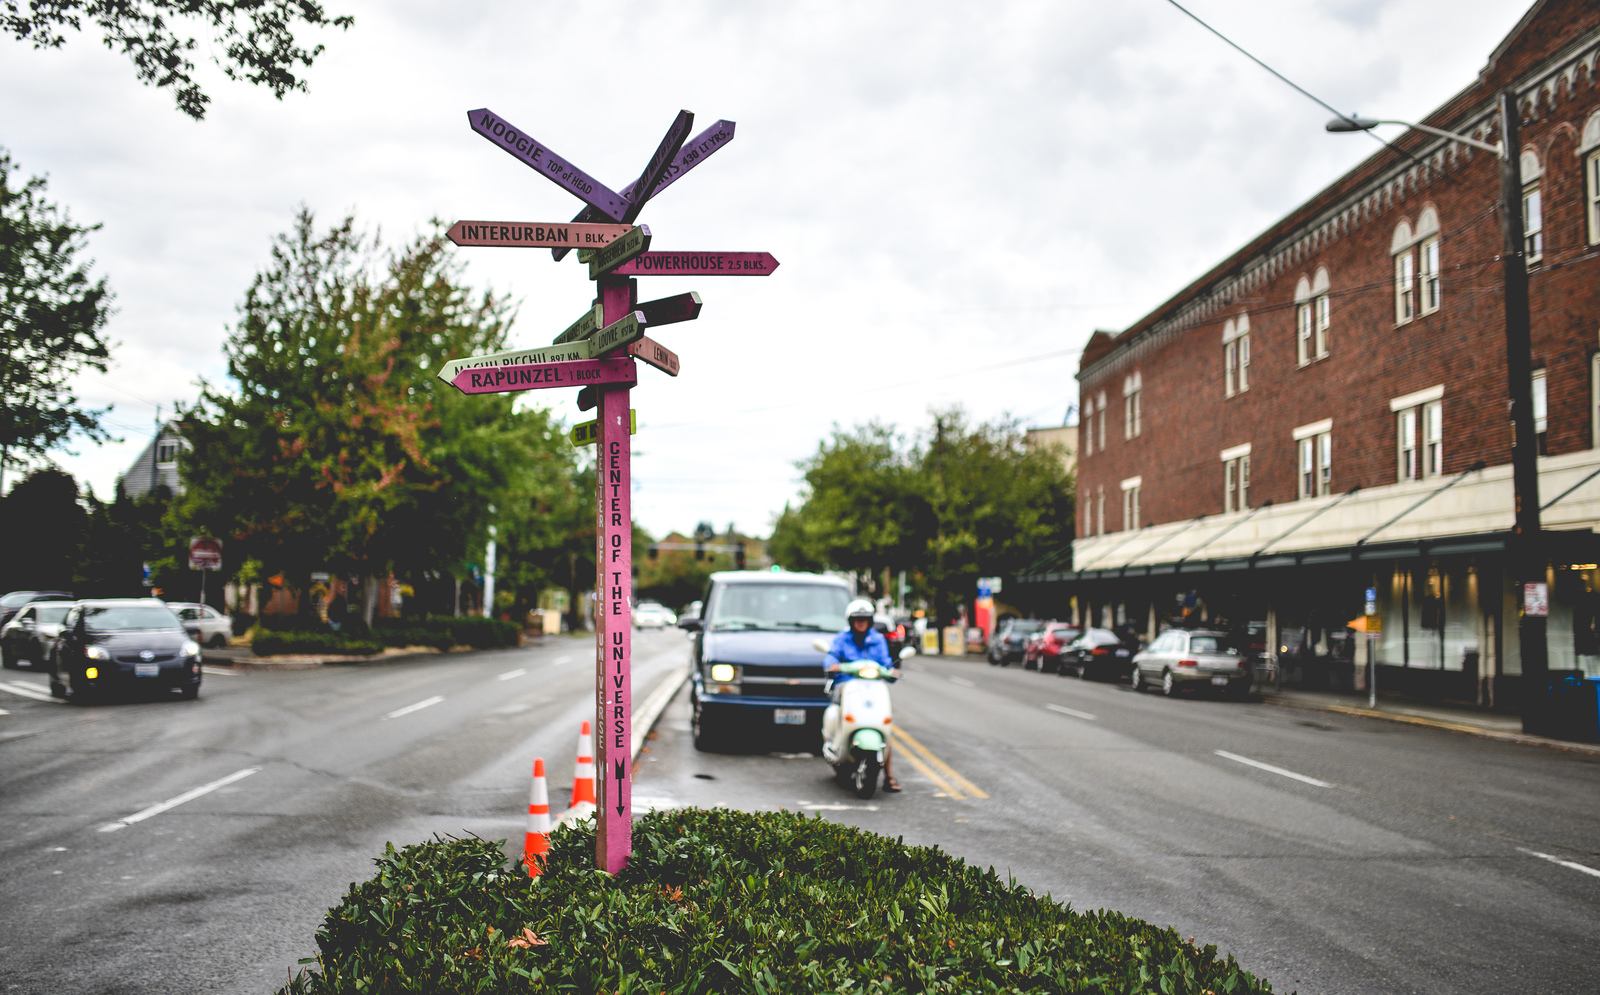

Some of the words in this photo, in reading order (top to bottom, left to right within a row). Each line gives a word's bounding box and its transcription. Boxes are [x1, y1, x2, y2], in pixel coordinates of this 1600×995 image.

[481, 114, 543, 161] NOOGIE
[547, 160, 563, 174] TOP
[562, 172, 573, 181] of
[571, 177, 592, 194] HEAD
[682, 149, 699, 165] 430
[699, 141, 710, 155] LT
[461, 225, 569, 242] INTERURBAN
[576, 233, 580, 242] 1
[585, 233, 609, 243] BLK.
[635, 256, 723, 270] POWERHOUSE
[728, 260, 741, 270] 2.5
[744, 260, 767, 270] BLKS.
[599, 327, 618, 349] LOUVRE
[471, 368, 562, 387] RAPUNZEL
[577, 368, 601, 380] BLOCK
[610, 441, 622, 526] CENTER
[611, 534, 622, 563] OF
[612, 572, 622, 615] THE
[613, 632, 624, 748] UNIVERSE
